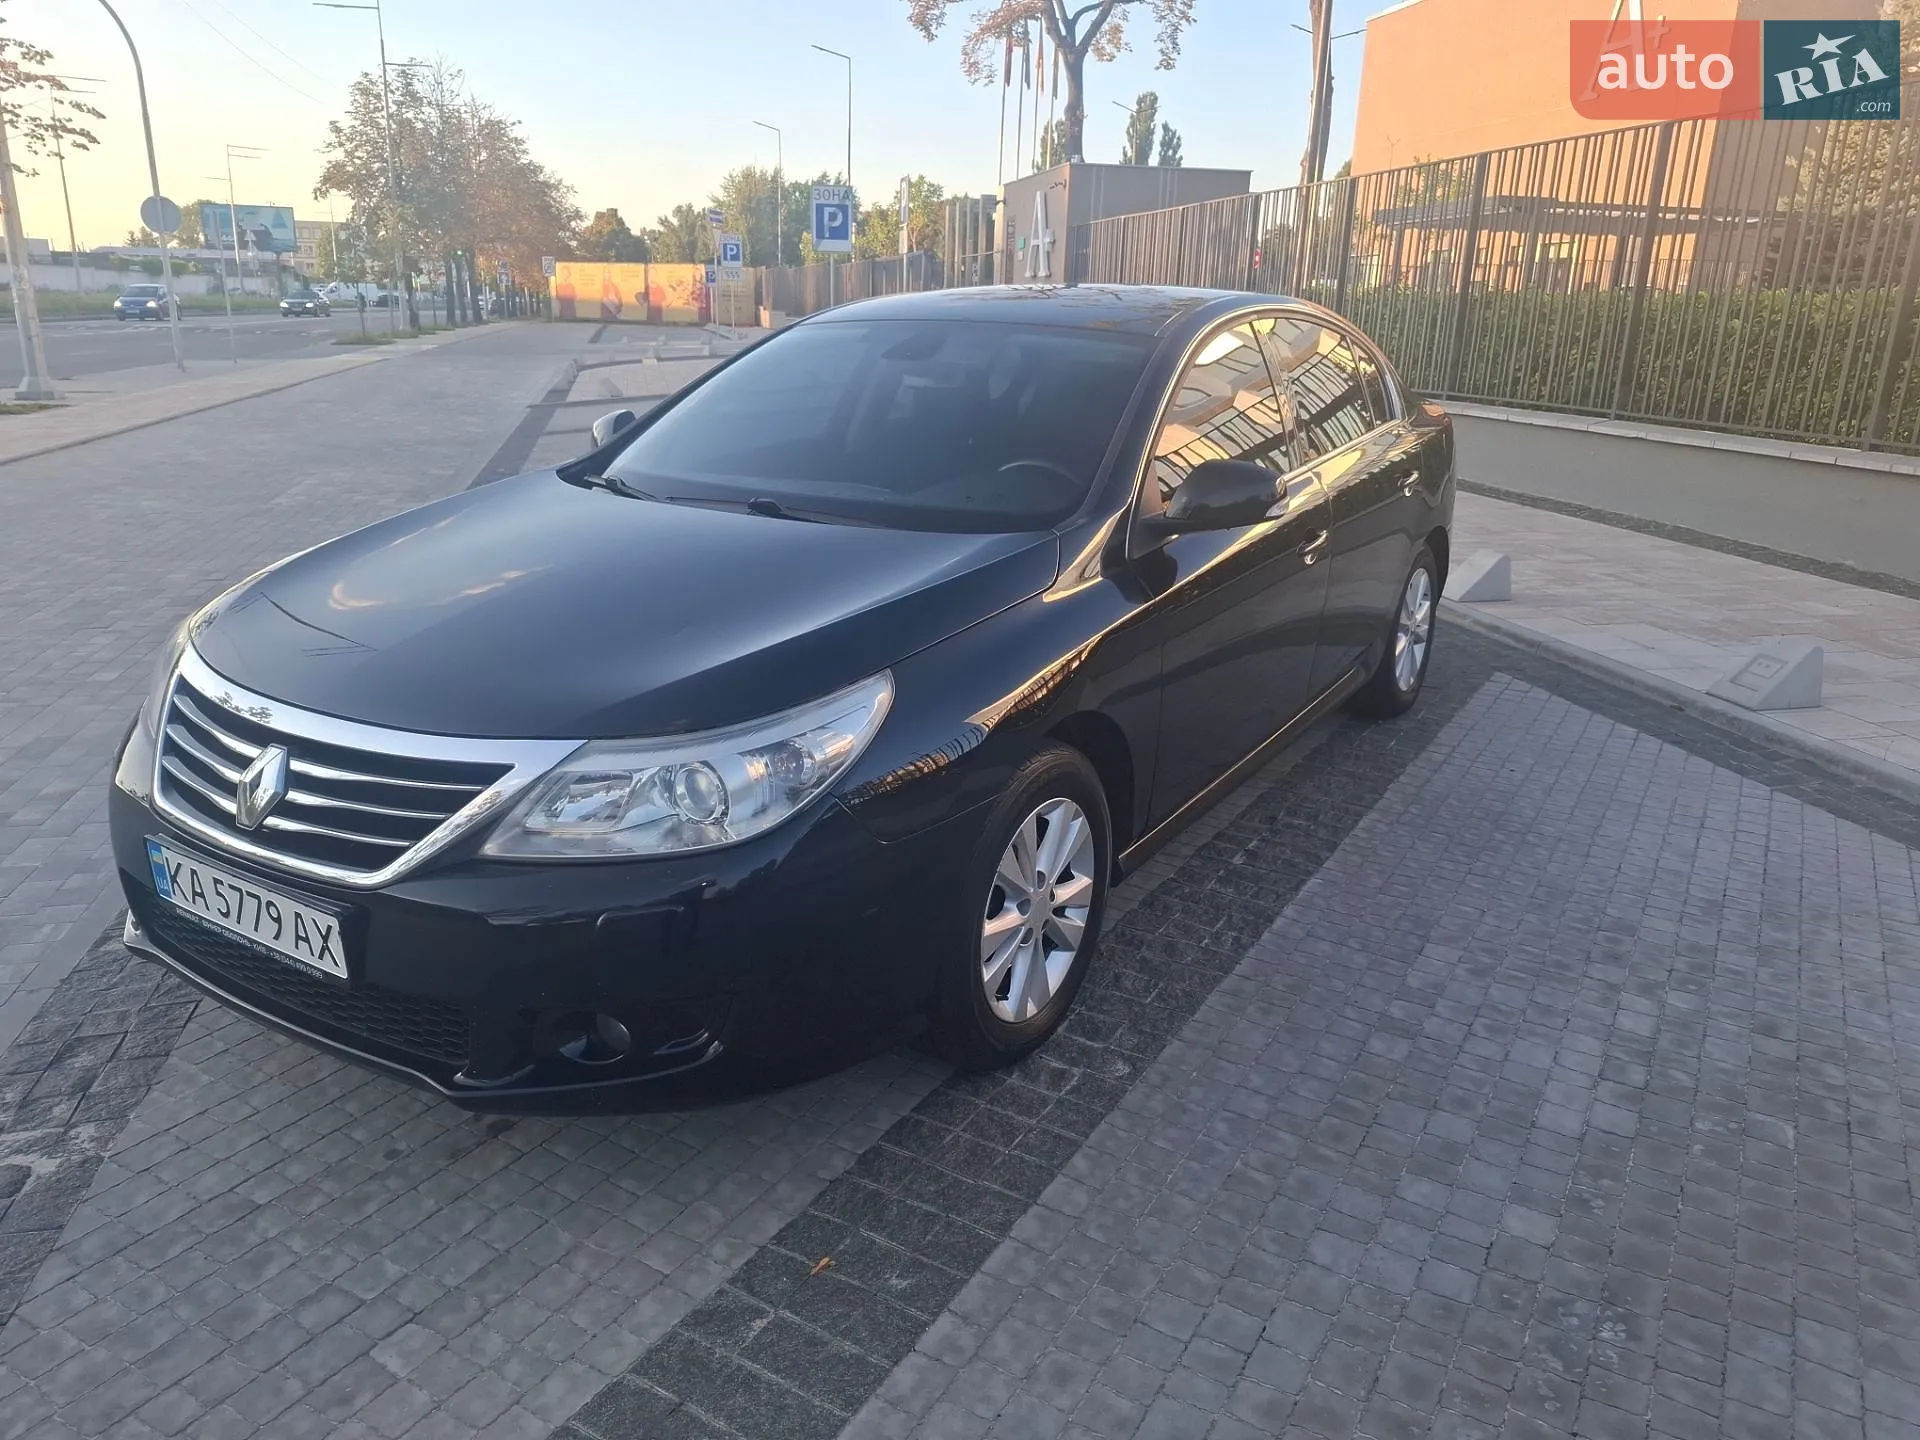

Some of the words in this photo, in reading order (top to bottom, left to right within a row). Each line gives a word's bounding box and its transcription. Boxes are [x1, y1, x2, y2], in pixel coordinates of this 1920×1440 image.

[813, 188, 851, 201] ЗОНА
[823, 207, 843, 238] P
[165, 856, 210, 912] KA
[212, 877, 283, 941] 5779
[293, 911, 340, 968] AX
